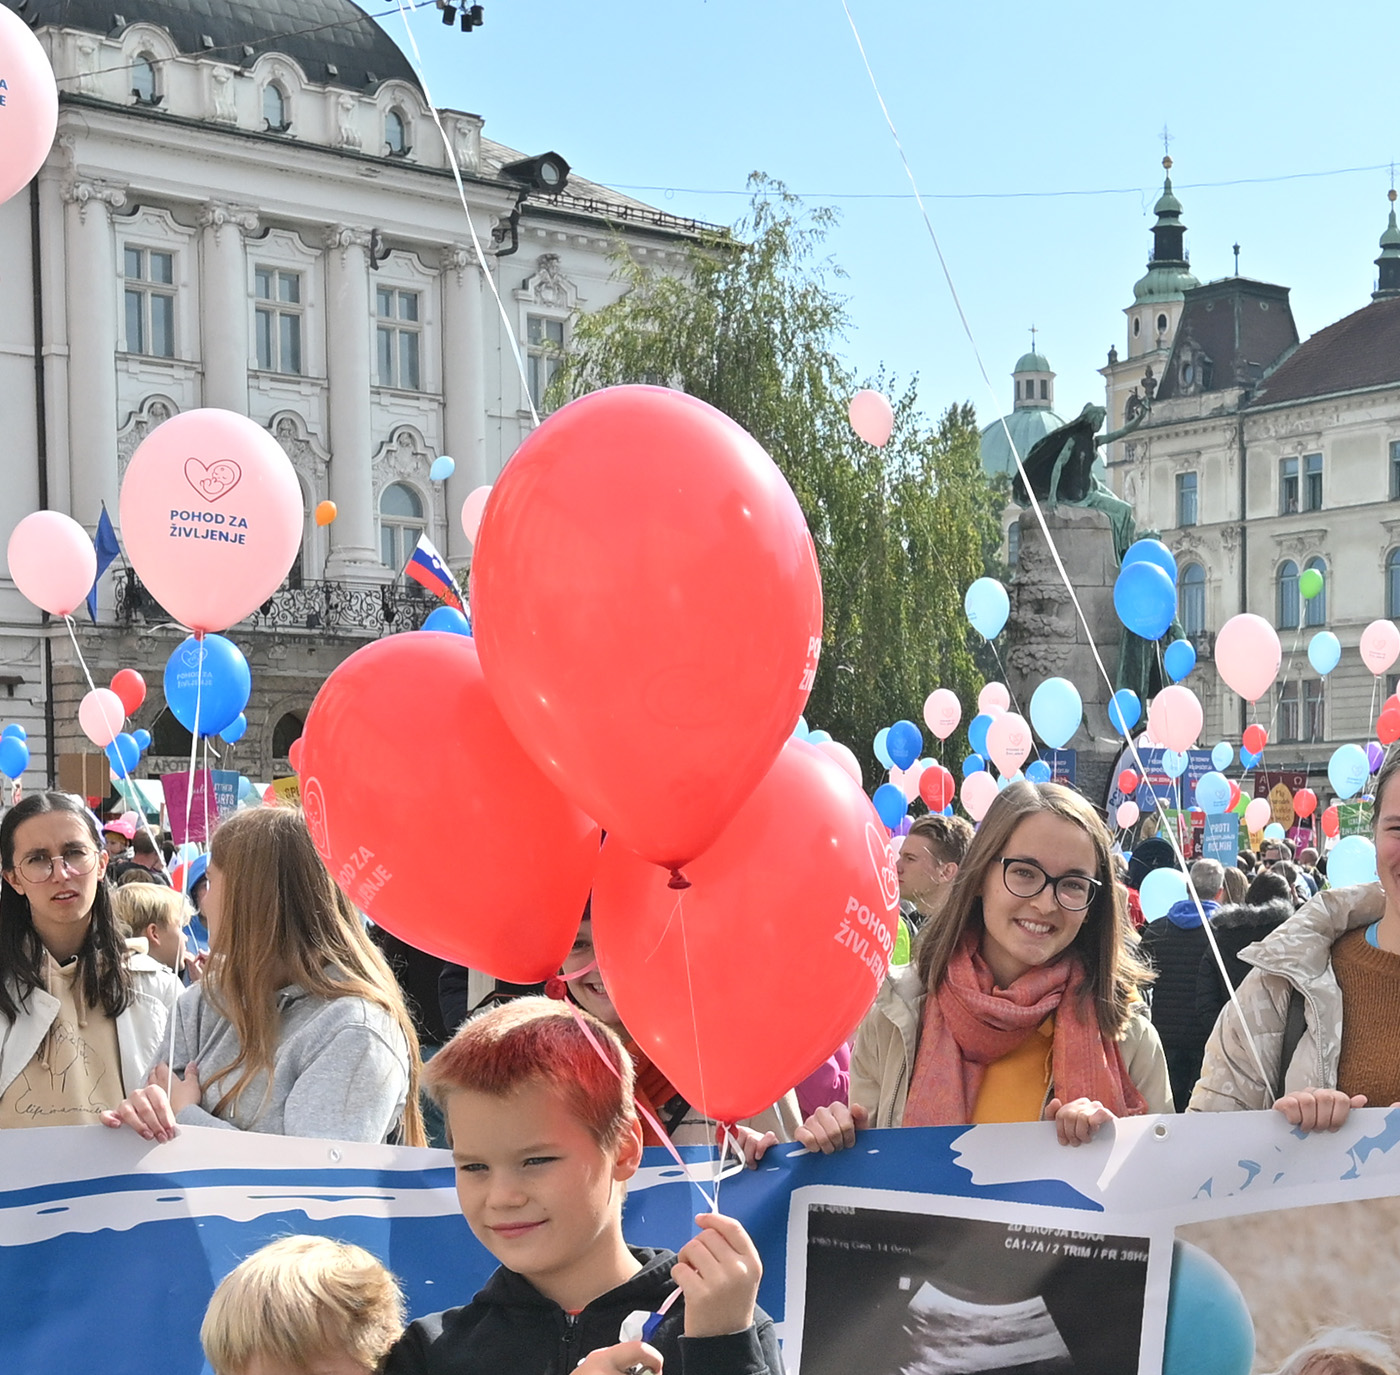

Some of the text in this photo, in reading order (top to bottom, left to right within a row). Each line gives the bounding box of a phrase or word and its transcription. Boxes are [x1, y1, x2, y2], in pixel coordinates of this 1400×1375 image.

[171, 510, 249, 529] POHOD ZA
[169, 523, 246, 545] ŽIVLJENJE
[350, 845, 375, 871] ZA
[845, 896, 891, 952] POHOD
[1052, 1244, 1060, 1255] 2
[1063, 1245, 1091, 1258] TRIM
